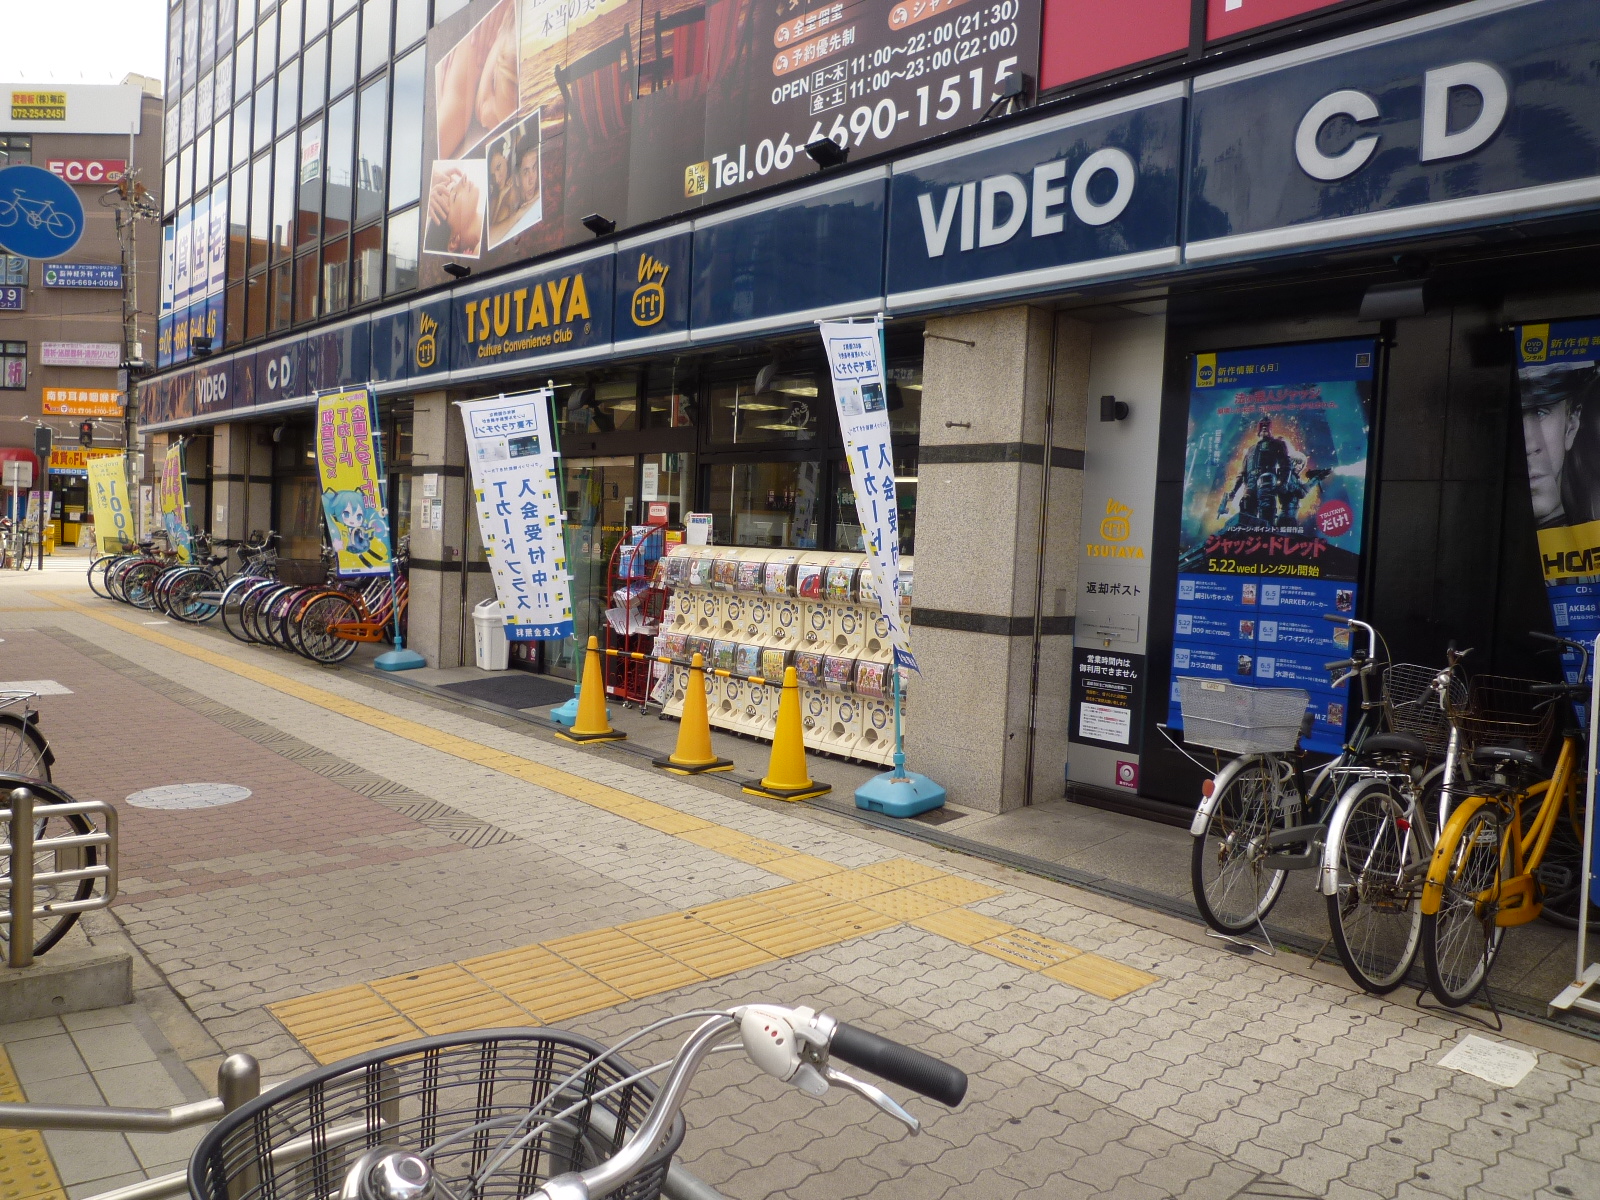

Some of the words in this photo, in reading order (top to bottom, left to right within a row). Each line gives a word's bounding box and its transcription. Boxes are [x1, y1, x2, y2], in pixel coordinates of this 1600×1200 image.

[793, 3, 844, 37] 全室個室
[791, 26, 856, 67] 予約優先制
[771, 77, 810, 105] OPEN
[12, 108, 65, 119] 072-254-2451
[49, 161, 104, 181] ECC
[687, 174, 707, 195] 2階
[917, 148, 1136, 259] VIDEO
[465, 273, 591, 344] TSUTAYA
[478, 341, 502, 358] Culture
[503, 334, 552, 354] Convenience
[553, 329, 574, 345] Club
[267, 356, 291, 390] CD
[1199, 369, 1213, 377] DVD
[197, 372, 227, 404] VIDEO
[1319, 506, 1346, 520] TSUTAYA
[1321, 514, 1350, 533] だけ!
[1086, 543, 1145, 560] TSUTAYA
[1205, 534, 1328, 558] ジャッジ・ドレッド
[1208, 558, 1236, 573] 5.22
[1237, 564, 1257, 575] wed
[1260, 563, 1320, 578] レンタル開始
[1086, 581, 1141, 597] 返却ポスト
[1575, 586, 1588, 594] CD
[1568, 604, 1597, 613] AKB48
[1079, 663, 1138, 679] 御利用できません
[1086, 653, 1132, 669] 営業時間内は
